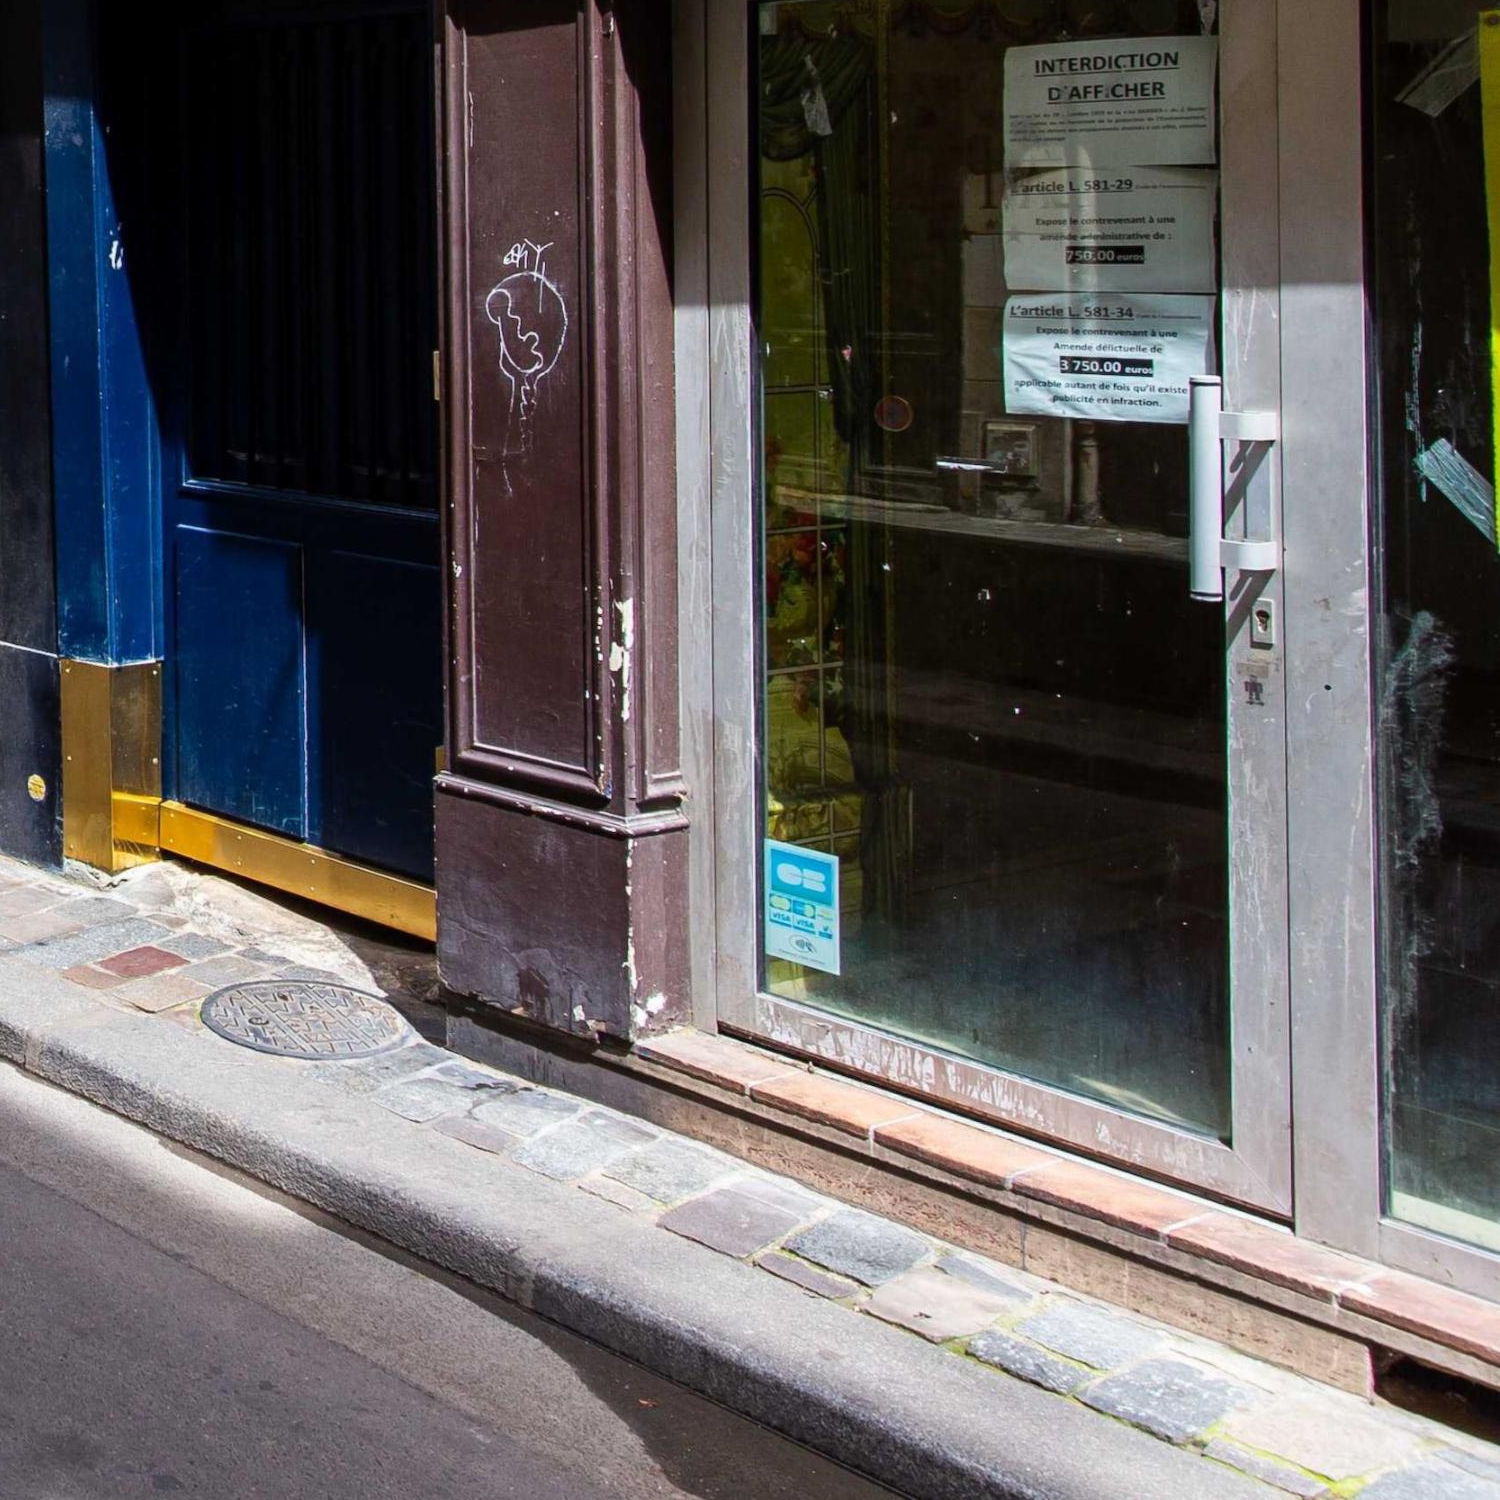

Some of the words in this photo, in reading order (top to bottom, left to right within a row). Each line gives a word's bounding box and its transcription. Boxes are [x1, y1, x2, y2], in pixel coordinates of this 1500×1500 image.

[1035, 52, 1179, 74] INTERDICTION
[1048, 82, 1165, 101] D'AFFICHER
[1083, 179, 1133, 191] 581-29
[1035, 218, 1067, 227] Expose
[1069, 217, 1079, 225] le
[1081, 216, 1147, 225] contrevenant
[1039, 232, 1077, 241] amende
[1080, 231, 1151, 241] administrative
[1152, 231, 1165, 240] de
[1066, 251, 1115, 261] 750.00
[1116, 253, 1145, 261] euros
[1010, 306, 1064, 317] L'article
[1068, 306, 1079, 317] L.
[1085, 306, 1134, 318] 581-34
[1036, 326, 1069, 336] Expose
[1071, 326, 1080, 334] le
[1082, 328, 1148, 337] contrevenant
[1053, 342, 1093, 351] Amende
[1096, 343, 1148, 353] délictuelle
[1150, 345, 1163, 353] de
[1060, 360, 1069, 370] 3
[1072, 361, 1121, 373] 750.00
[1124, 366, 1154, 375] euros
[1014, 379, 1062, 389] applicable
[1065, 381, 1096, 390] autant
[1098, 382, 1111, 390] de
[1112, 383, 1130, 392] fois
[1133, 384, 1156, 395] qu'il
[1158, 385, 1188, 395] existe
[1052, 394, 1094, 405] publicité
[1110, 397, 1163, 407] infraction.
[772, 911, 791, 923] VISA
[796, 918, 815, 929] VISA
